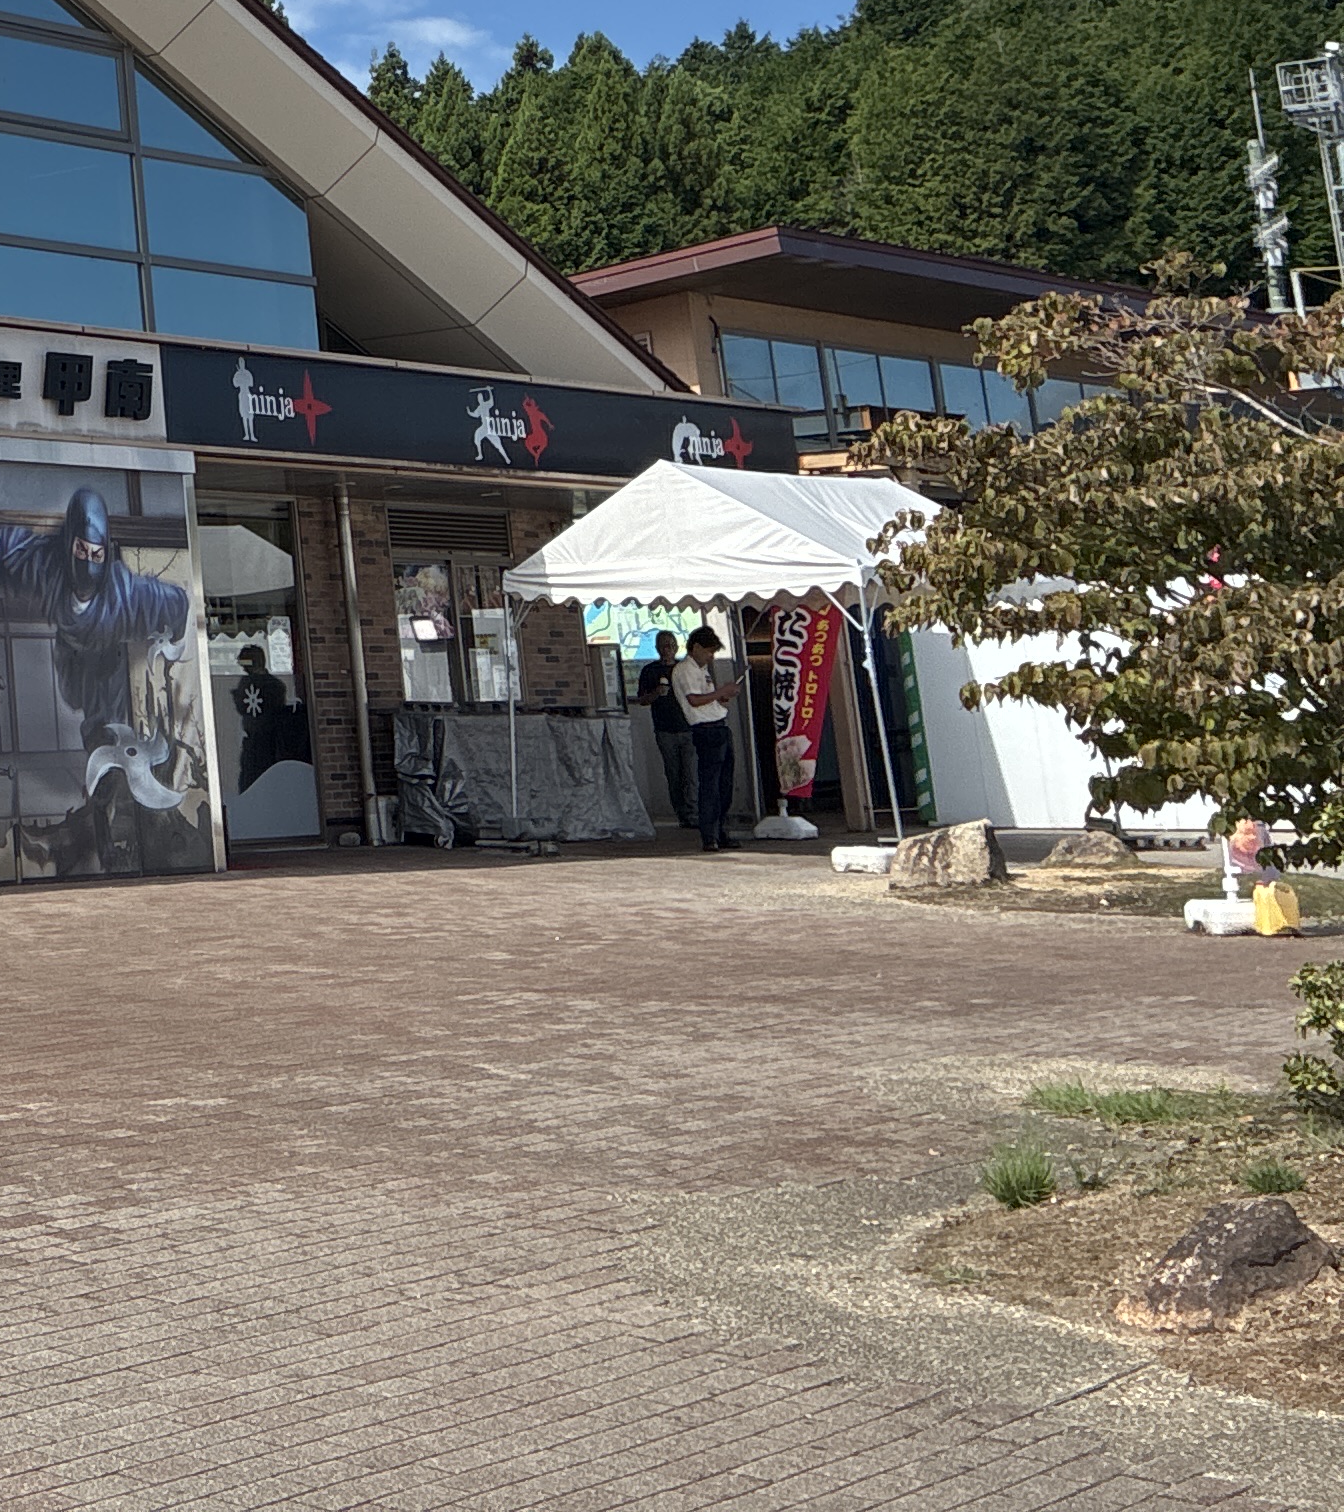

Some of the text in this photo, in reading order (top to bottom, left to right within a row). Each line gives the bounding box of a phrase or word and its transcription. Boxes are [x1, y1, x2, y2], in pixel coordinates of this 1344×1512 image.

[42, 351, 154, 421] 甲南
[247, 385, 296, 421] ninja
[485, 408, 527, 442] ninja
[688, 429, 726, 459] ninja
